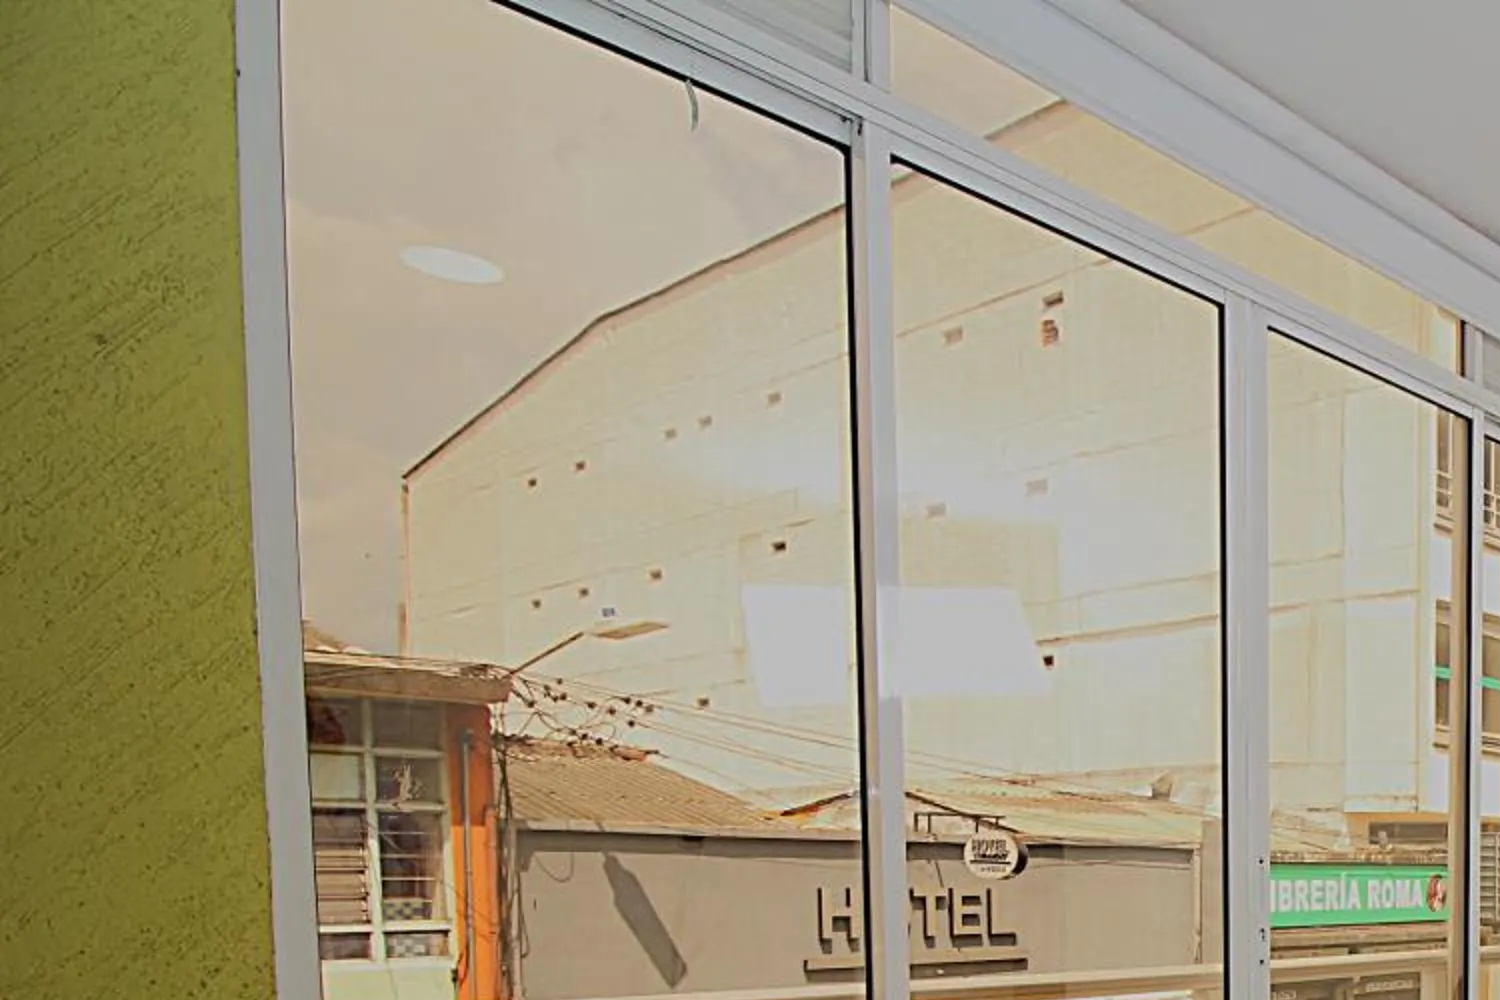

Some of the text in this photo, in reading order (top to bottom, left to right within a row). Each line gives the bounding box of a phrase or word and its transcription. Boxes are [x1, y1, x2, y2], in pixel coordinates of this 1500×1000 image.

[817, 886, 1017, 953] HTEL
[1270, 872, 1423, 913] IBRERÍA ROMA
